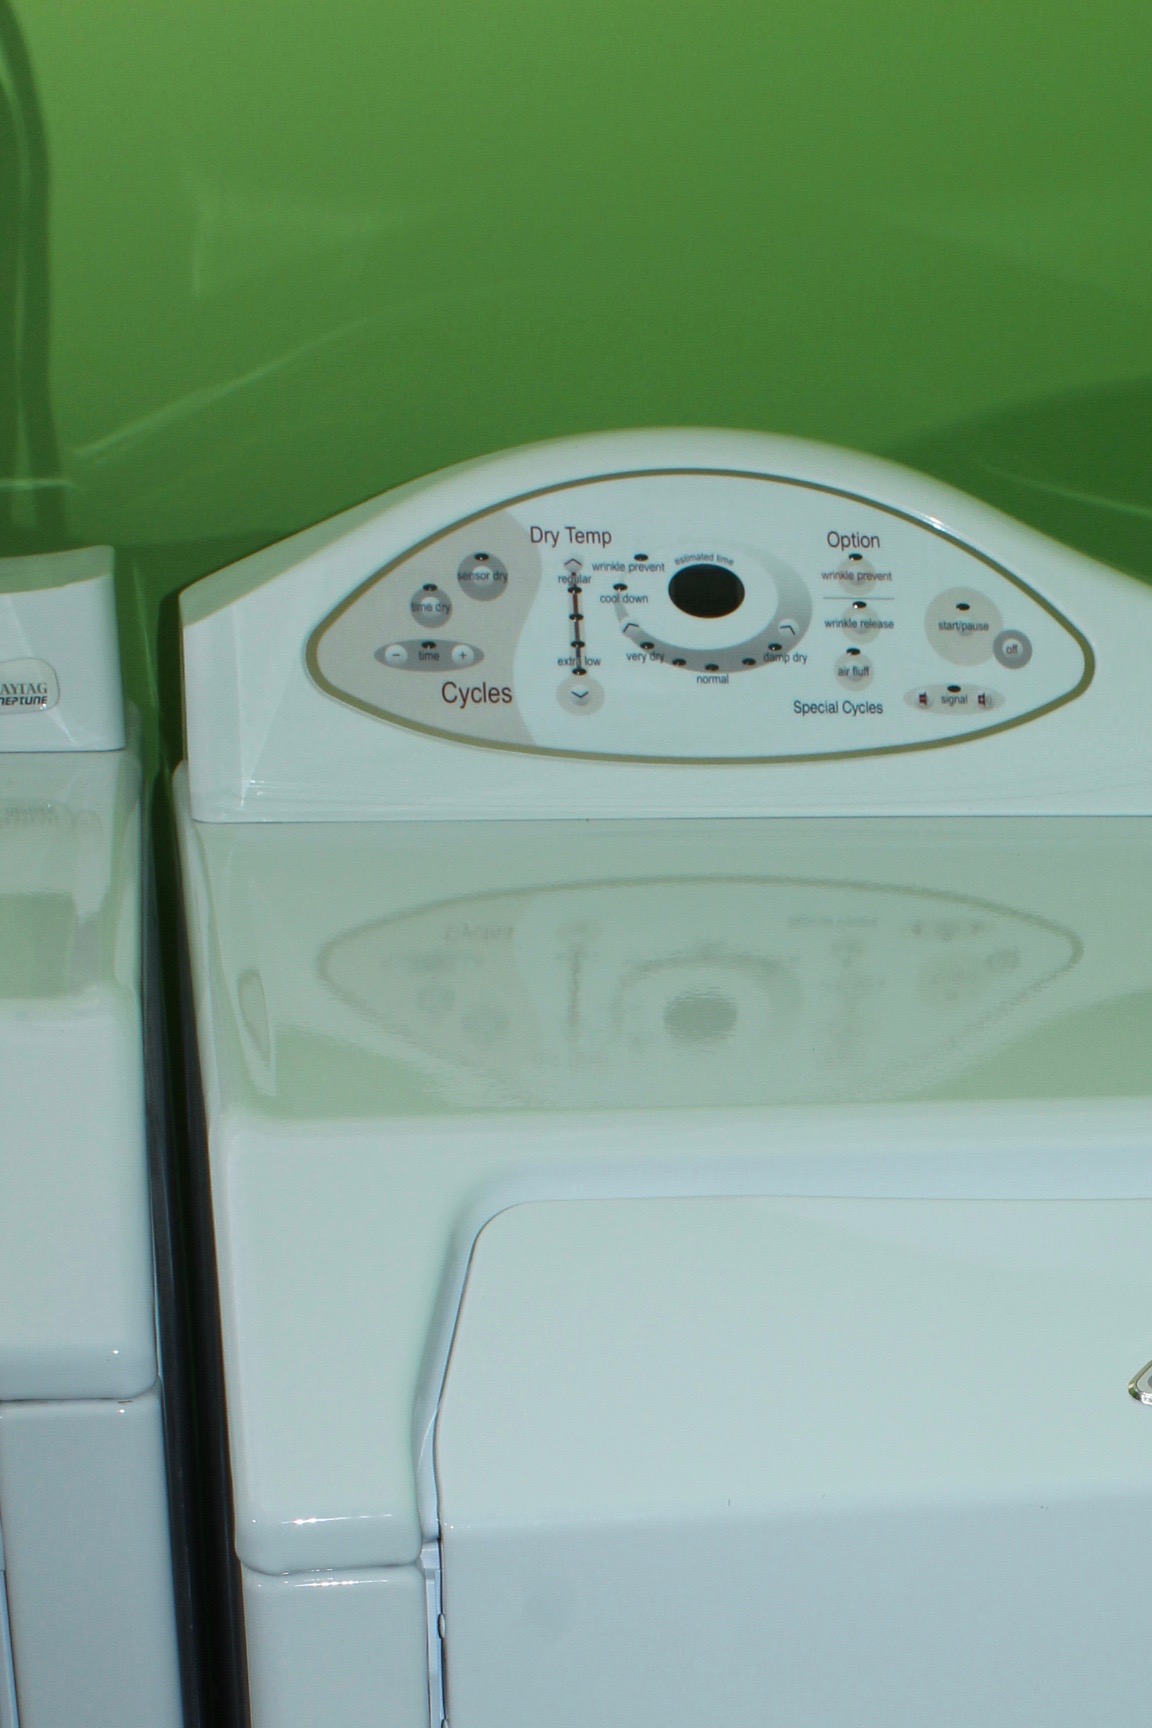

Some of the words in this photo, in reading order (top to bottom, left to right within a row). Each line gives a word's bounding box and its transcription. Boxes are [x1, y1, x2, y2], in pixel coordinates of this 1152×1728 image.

[530, 526, 559, 547] Dry
[565, 527, 612, 547] Temp
[827, 531, 880, 551] Option
[675, 553, 714, 565] estimated
[716, 554, 734, 566] time
[592, 561, 626, 572] wrinkle
[628, 562, 665, 574] prevent
[457, 570, 490, 581] sensor
[492, 569, 508, 583] dry
[558, 573, 591, 585] regular
[821, 570, 855, 581] wrinkle
[857, 570, 892, 583] prevent
[600, 593, 620, 604] cool
[622, 593, 648, 604] down
[411, 601, 433, 612] time
[435, 601, 451, 615] dry
[824, 618, 858, 629] wrinkle
[860, 618, 894, 629] release
[938, 619, 989, 632] start/pause
[418, 650, 440, 661] time
[1005, 644, 1019, 655] off
[557, 655, 582, 666] extra
[584, 655, 601, 666] low
[626, 652, 647, 664] very
[648, 650, 665, 663] dry
[763, 652, 791, 664] damp
[793, 652, 807, 665] dry
[838, 666, 850, 677] air
[852, 665, 870, 677] fluff
[697, 674, 729, 684] normal
[0, 683, 47, 694] AYTAG
[441, 681, 513, 708] Cycles
[941, 694, 968, 706] signal
[793, 700, 839, 716] Special
[842, 700, 884, 716] Cycles
